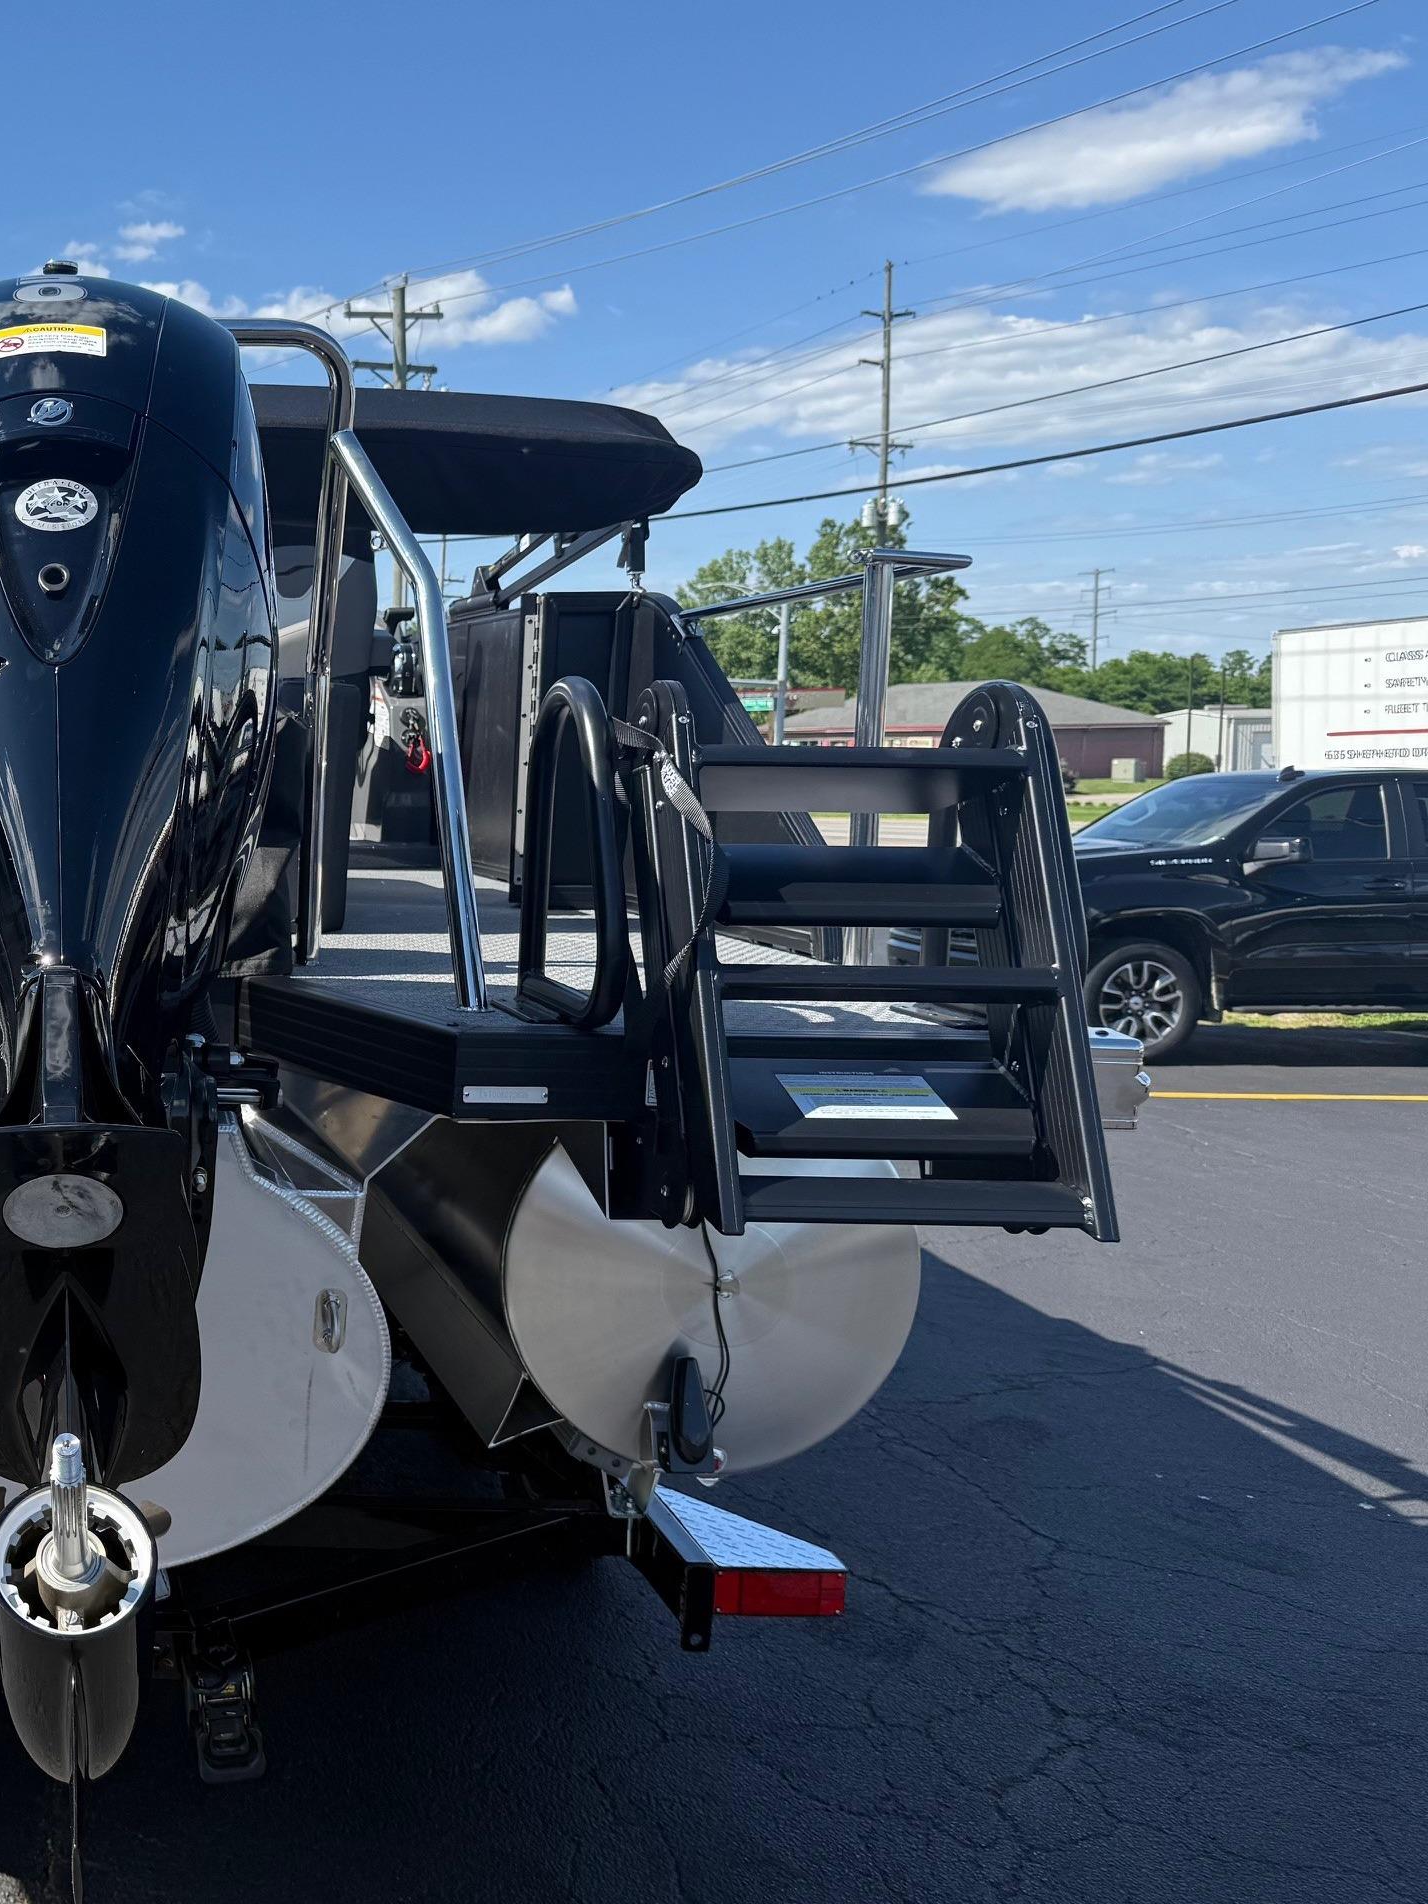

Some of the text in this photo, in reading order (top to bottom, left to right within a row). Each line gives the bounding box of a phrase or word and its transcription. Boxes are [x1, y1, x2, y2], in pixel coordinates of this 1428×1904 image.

[26, 481, 90, 496] ULTRA LOW
[1385, 650, 1424, 662] CLASS
